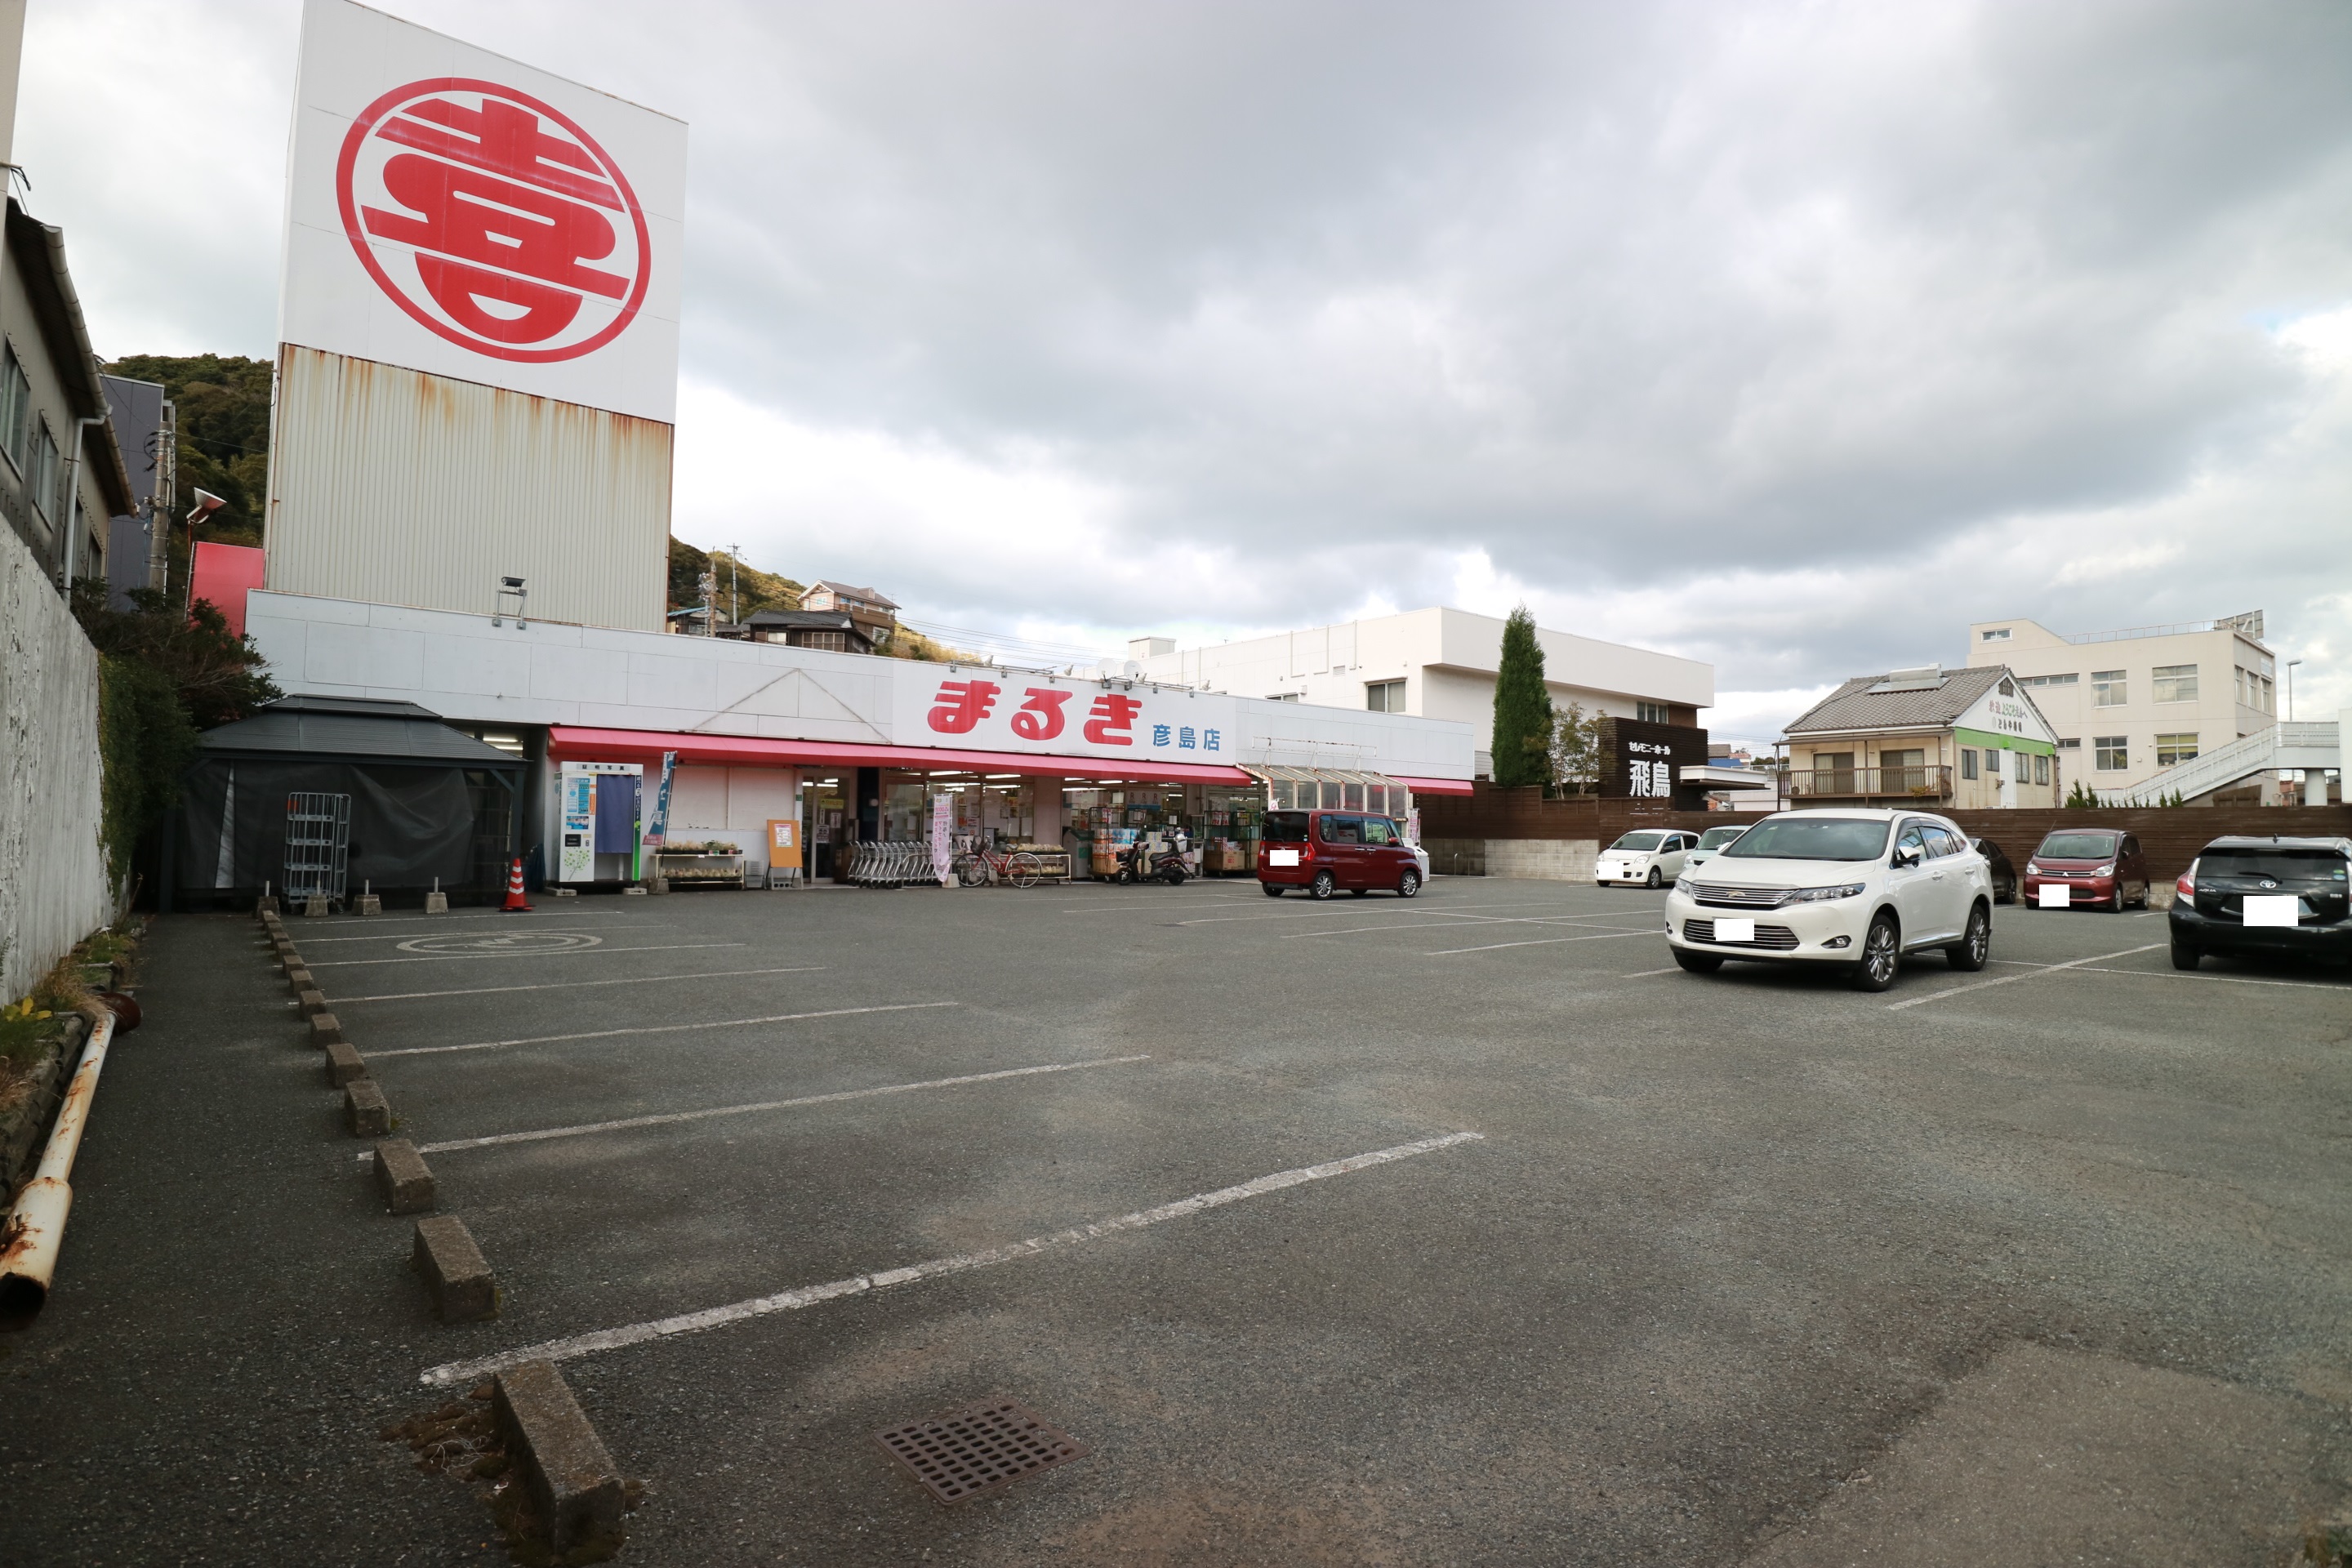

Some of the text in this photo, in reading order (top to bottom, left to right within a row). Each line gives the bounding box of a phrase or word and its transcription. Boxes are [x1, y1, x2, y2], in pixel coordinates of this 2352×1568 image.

[927, 679, 1143, 746] まるき
[1152, 724, 1221, 751] 彦島店
[1628, 742, 1671, 755] セレモニーホール
[1628, 760, 1671, 798] 飛鳥
